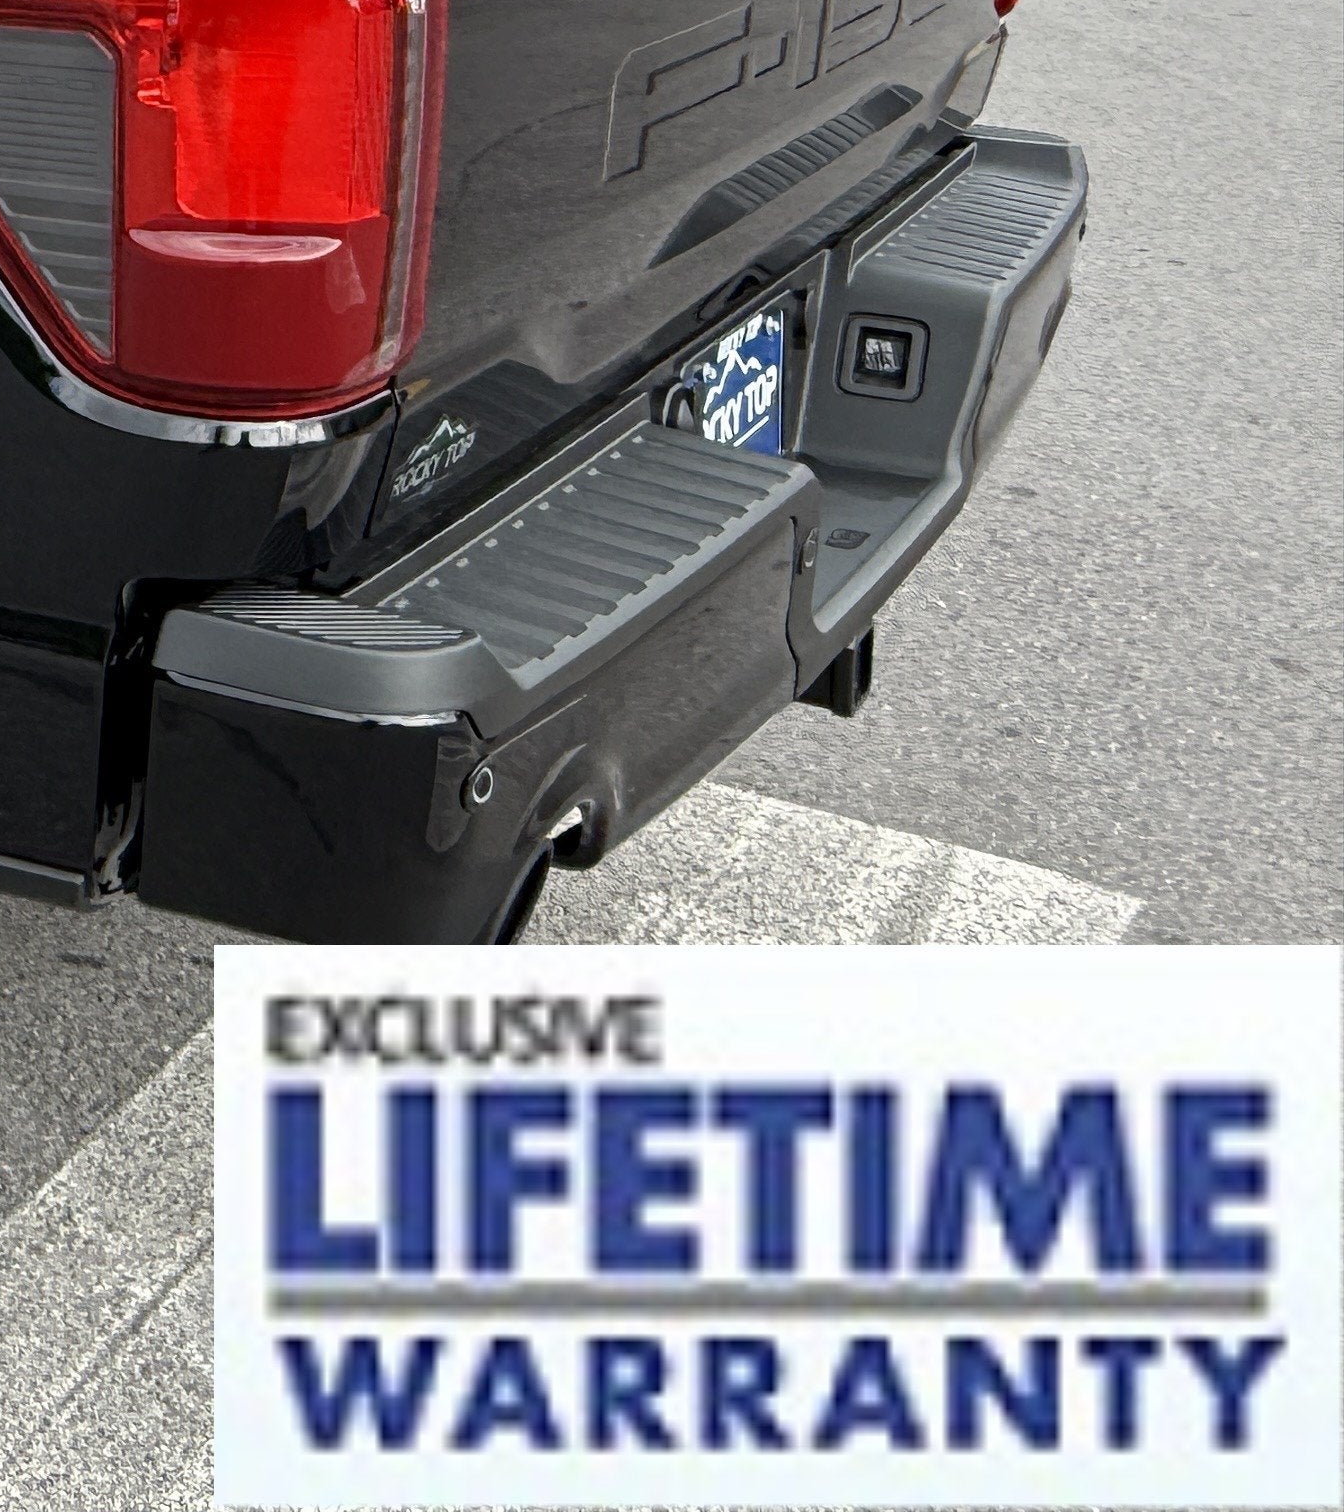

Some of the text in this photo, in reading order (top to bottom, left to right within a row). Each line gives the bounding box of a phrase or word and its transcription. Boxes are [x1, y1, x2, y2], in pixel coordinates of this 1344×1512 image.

[744, 365, 777, 422] TOP
[393, 431, 476, 497] ROCKY TOP
